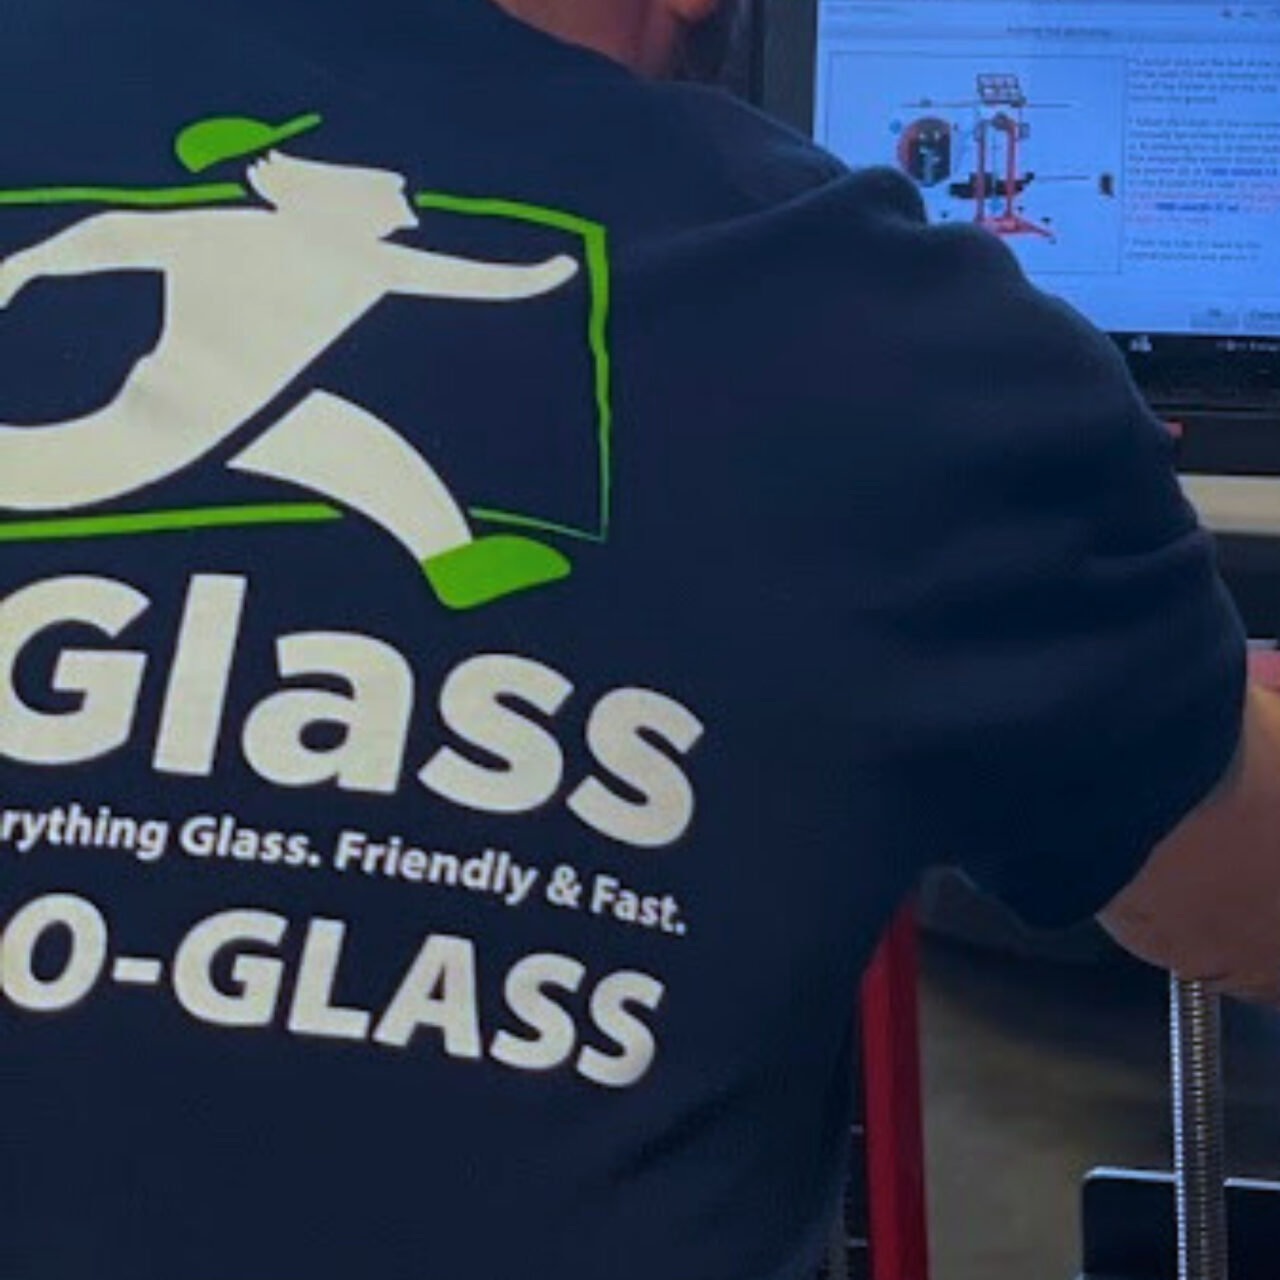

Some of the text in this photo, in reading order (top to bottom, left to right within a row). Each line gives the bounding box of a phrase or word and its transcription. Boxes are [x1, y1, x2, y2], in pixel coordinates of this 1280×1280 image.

[0, 573, 704, 848] Glass
[0, 803, 687, 935] rything Glass. Friendly & Fast.
